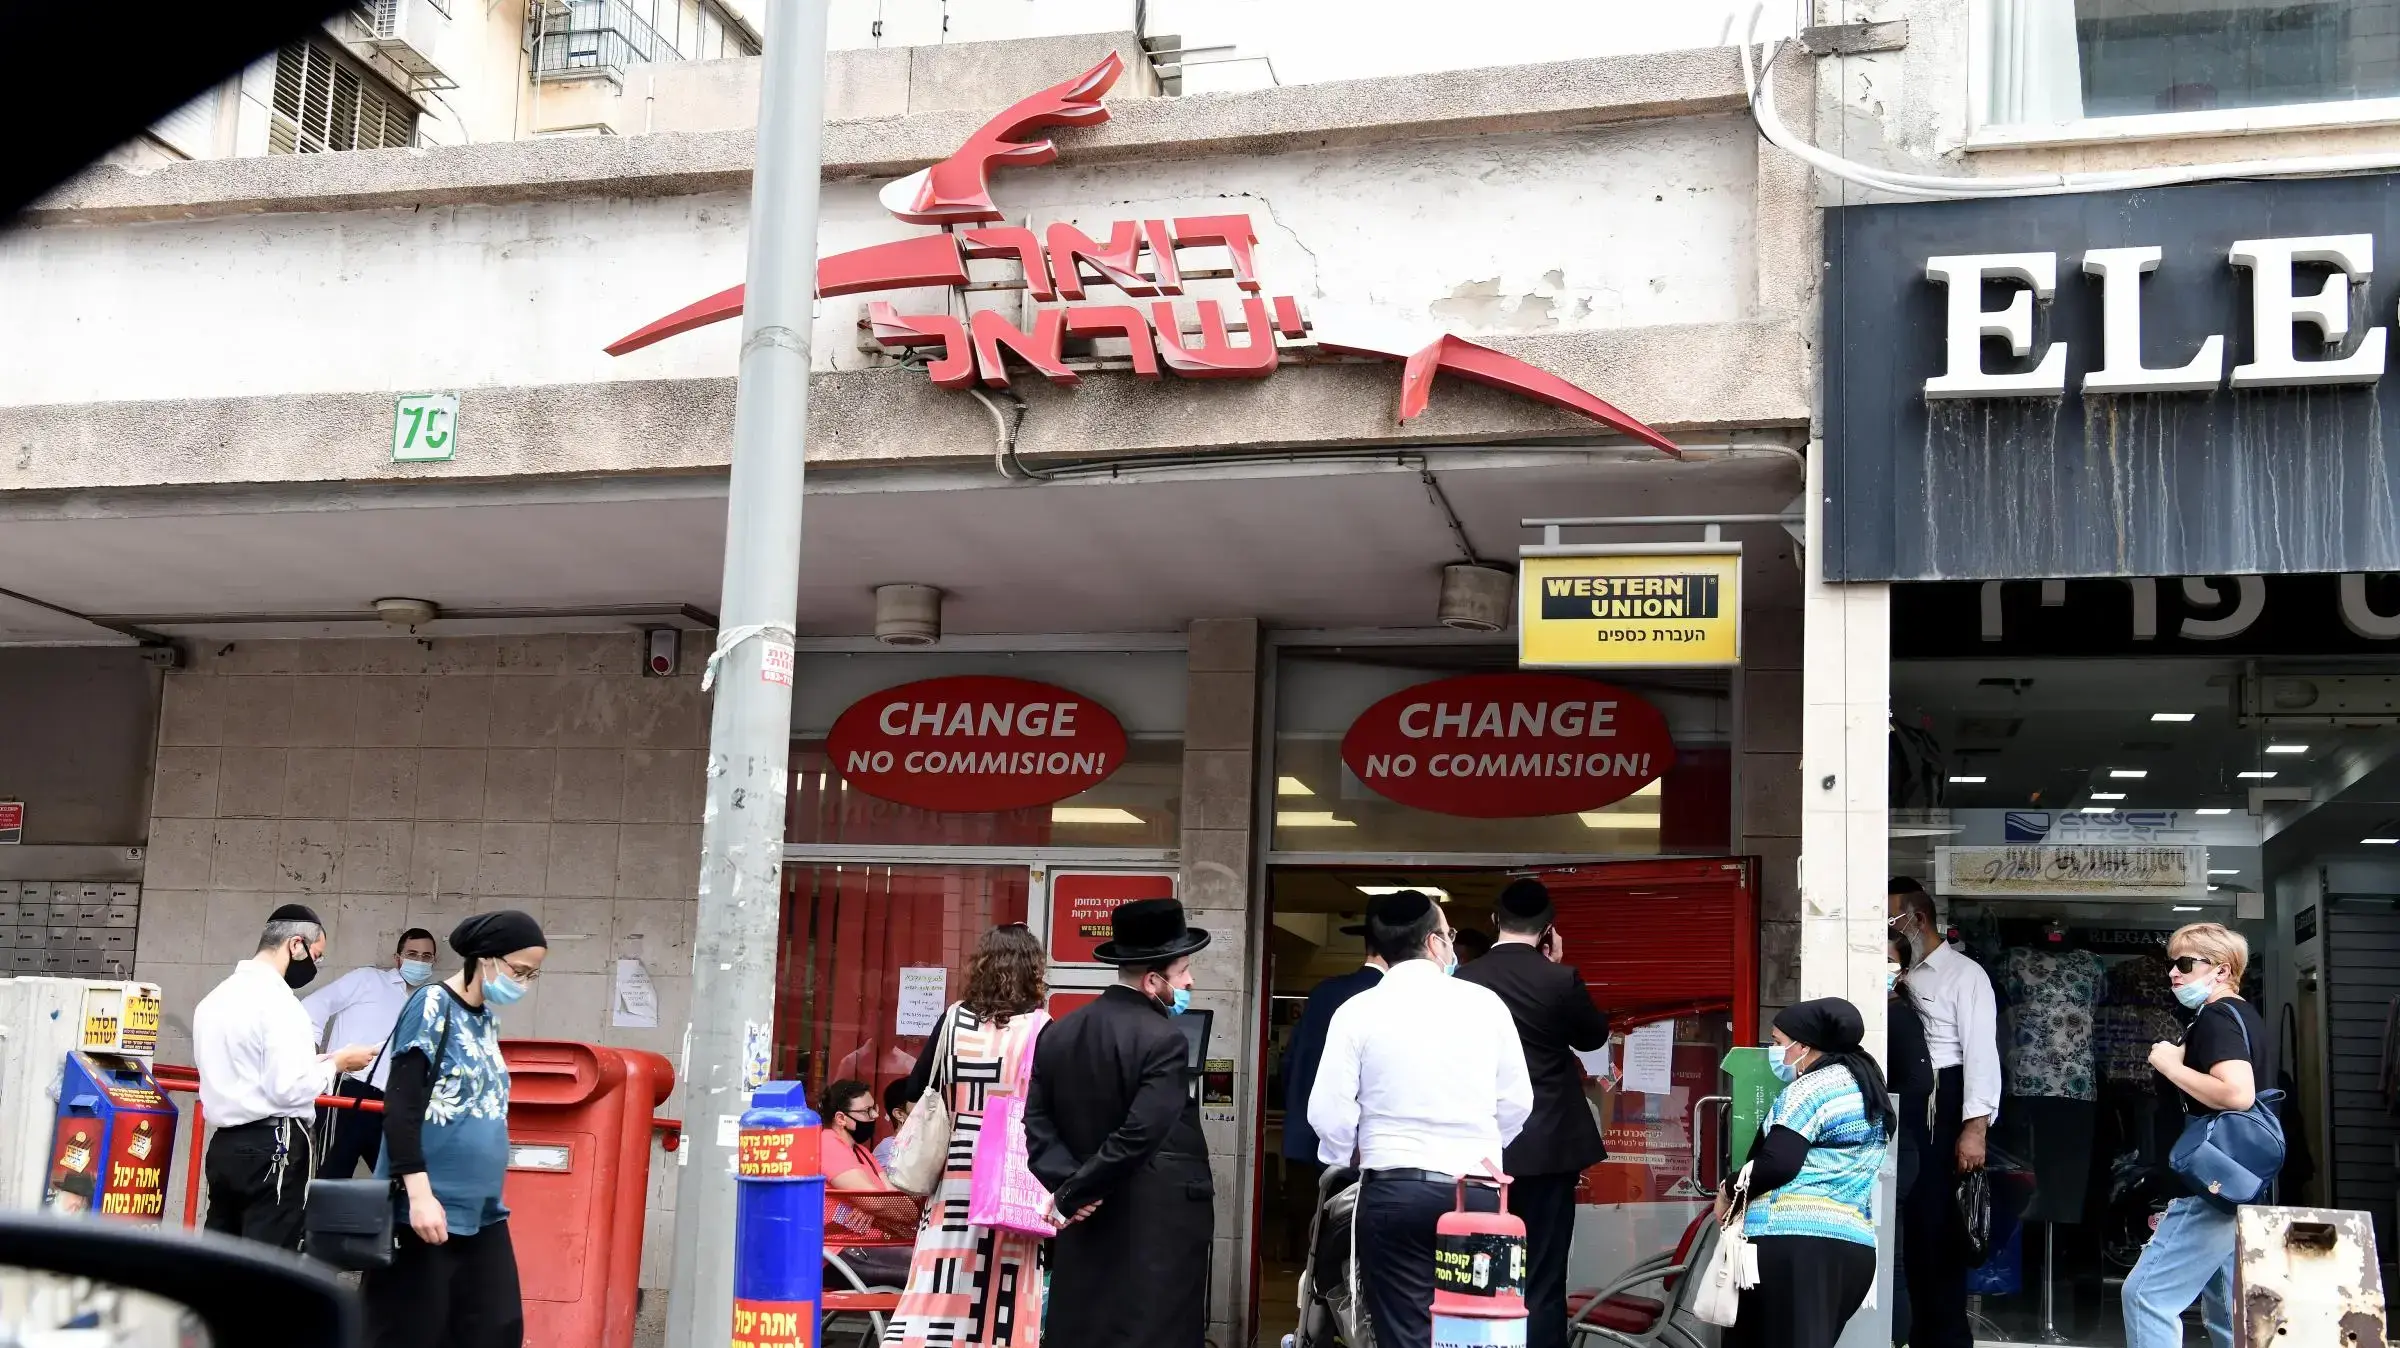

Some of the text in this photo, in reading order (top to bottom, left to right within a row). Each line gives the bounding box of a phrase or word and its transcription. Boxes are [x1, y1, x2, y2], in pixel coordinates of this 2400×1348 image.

[963, 214, 1260, 302] דואר
[1924, 233, 2400, 399] ELE
[868, 295, 1308, 390] ישראל
[1546, 577, 1683, 597] WESTERN
[1591, 598, 1683, 617] UNION
[1597, 628, 1706, 643] העברת כספים
[879, 702, 1078, 737] CHANGE
[1399, 701, 1618, 739] CHANGE
[847, 750, 1106, 775] NO COMMISION!
[1365, 752, 1651, 778] NO COMMISION!
[1074, 897, 1102, 907] במזומן
[1103, 897, 1120, 907] כסף
[1071, 909, 1092, 919] דקות
[1094, 909, 1109, 920] תוך
[2088, 930, 2172, 944] ELEGAN
[91, 1016, 118, 1030] חסדי
[84, 1030, 117, 1045] ישורון
[739, 1133, 794, 1149] קופת צדק
[752, 1147, 771, 1161] של
[113, 1160, 161, 1188] אתה יכול
[760, 1161, 793, 1176] קופת
[102, 1188, 163, 1215] להיות בטוח
[1444, 1250, 1471, 1270] קופת
[1454, 1267, 1472, 1284] של
[735, 1303, 798, 1337] אתה יכול
